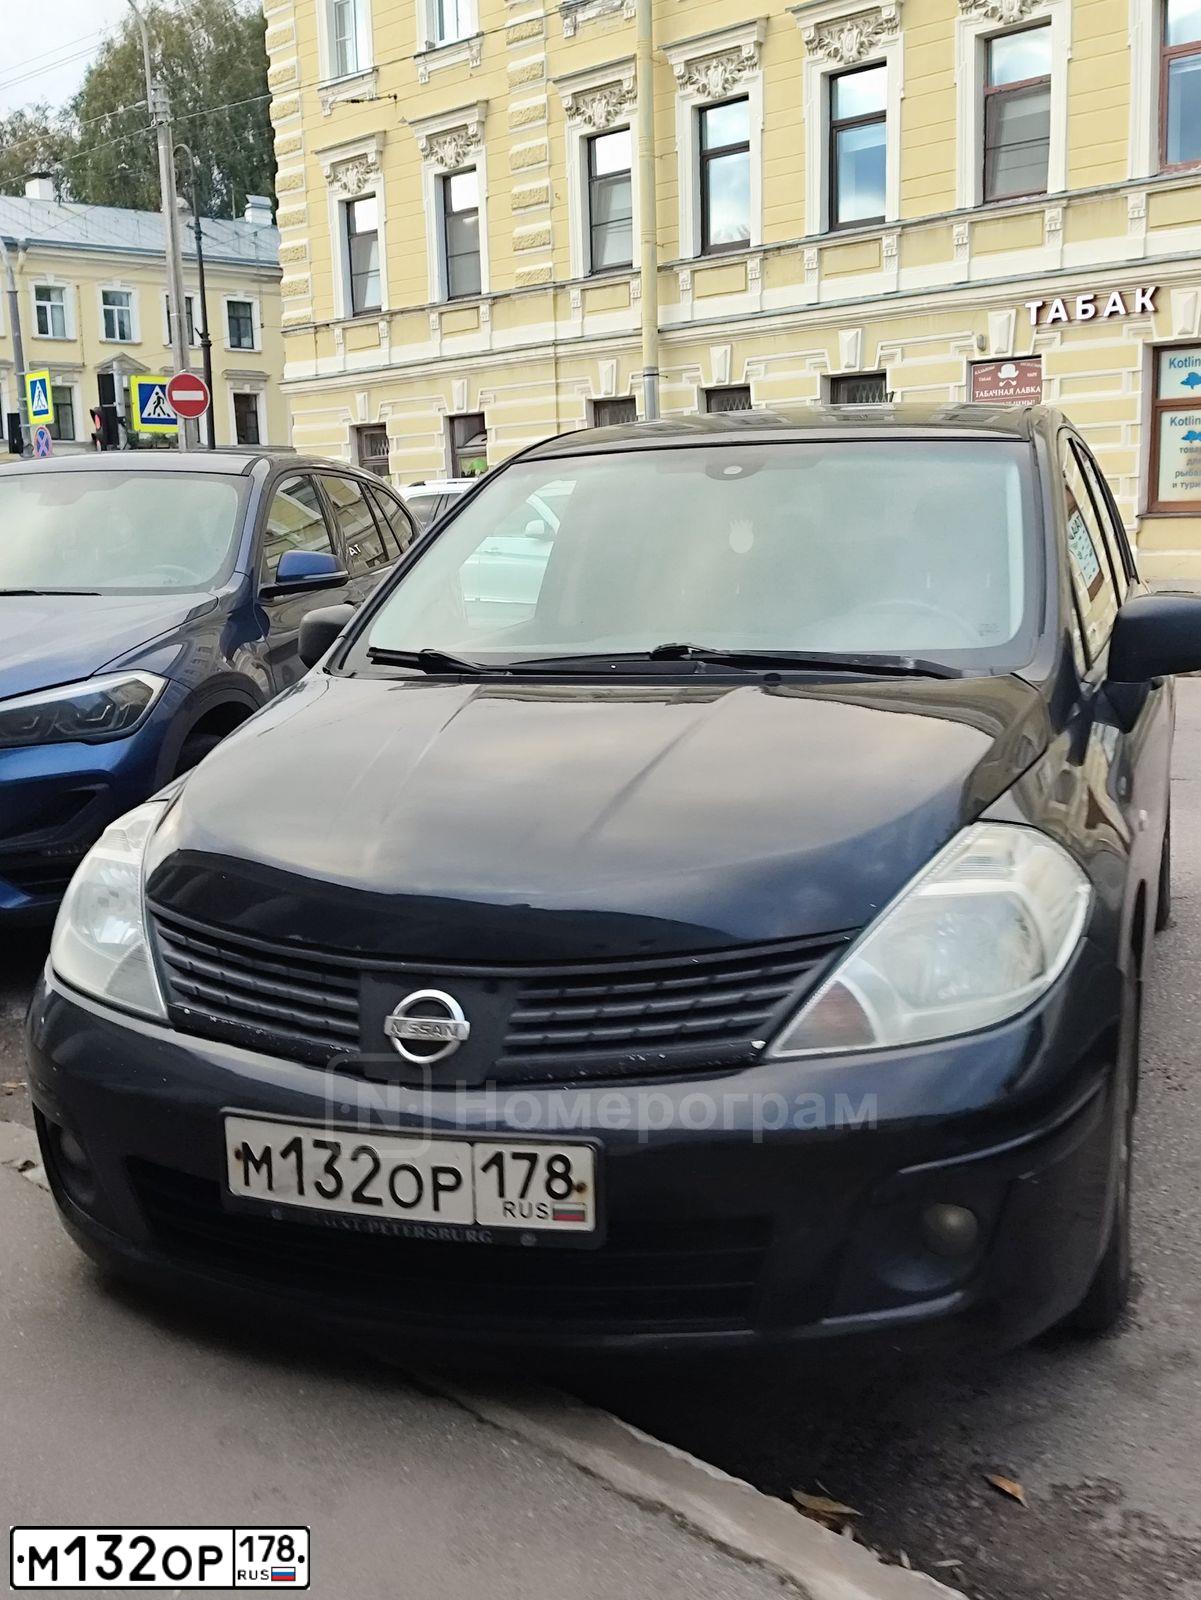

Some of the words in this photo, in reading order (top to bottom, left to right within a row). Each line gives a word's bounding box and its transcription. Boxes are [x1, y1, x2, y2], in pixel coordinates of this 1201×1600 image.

[1025, 286, 1159, 326] ТАБАК
[1169, 356, 1201, 369] Kotlin
[975, 389, 1014, 398] ТАБАЧНАЯ
[1015, 386, 1041, 395] ЛАВКА
[1170, 416, 1201, 427] Kotlin
[1179, 446, 1201, 454] това
[391, 1021, 459, 1040] NISSAN
[241, 1136, 463, 1212] М132ОР
[481, 1151, 574, 1200] 178
[502, 1201, 550, 1219] RUS
